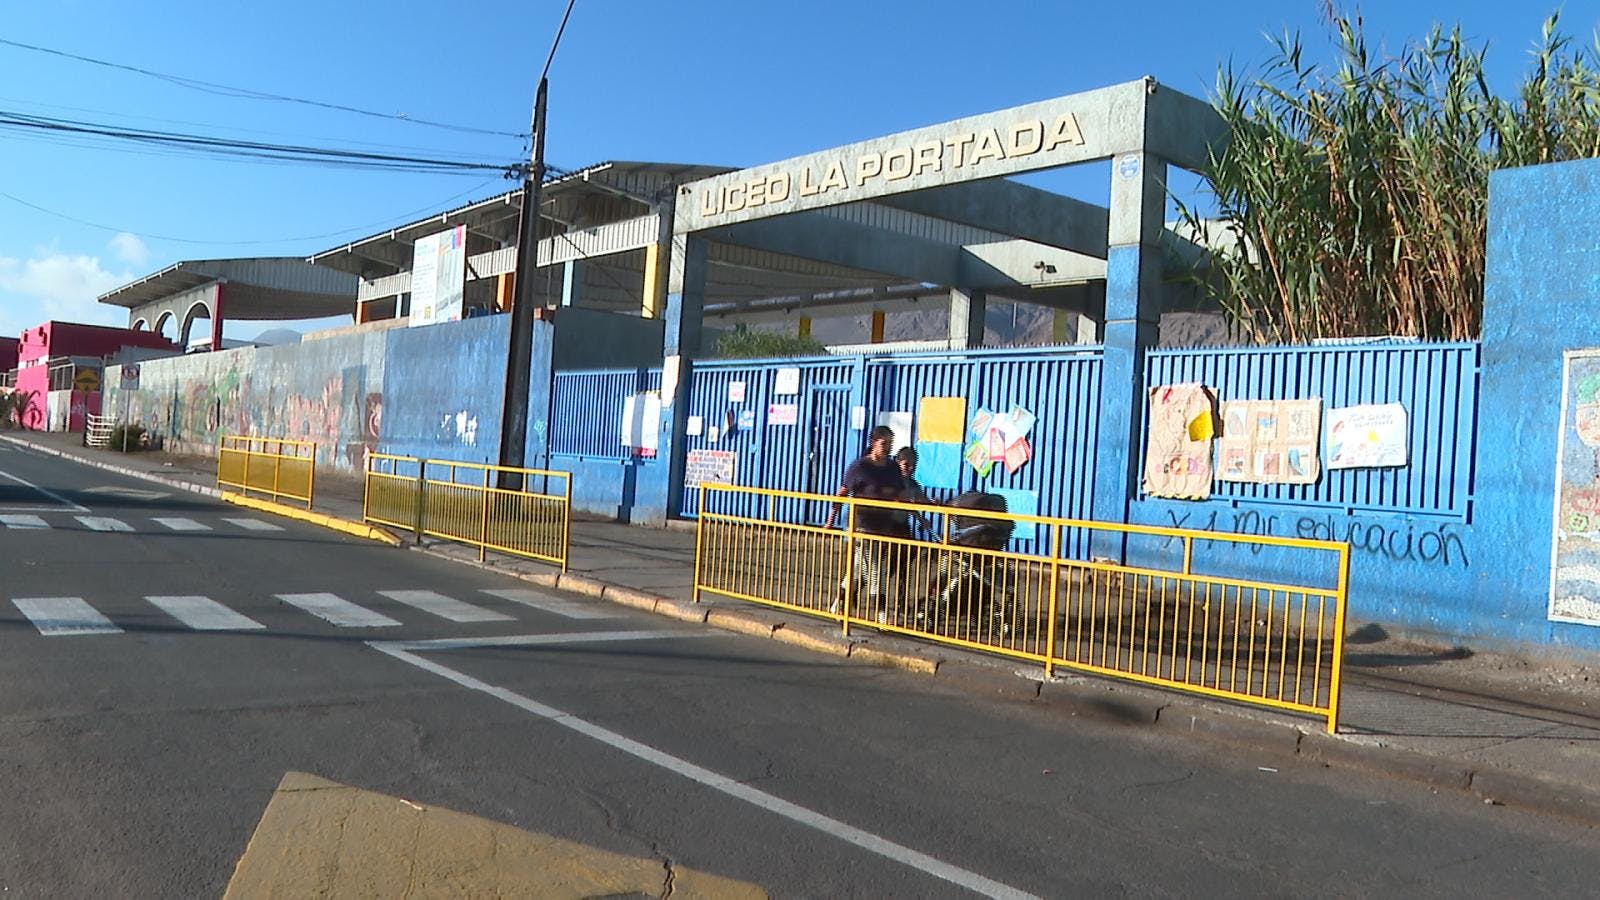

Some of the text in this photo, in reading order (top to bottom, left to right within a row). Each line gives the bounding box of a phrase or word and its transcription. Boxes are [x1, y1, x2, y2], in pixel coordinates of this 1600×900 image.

[700, 172, 791, 218] LICEO
[800, 159, 849, 198] LA
[855, 112, 1086, 187] PORTADA
